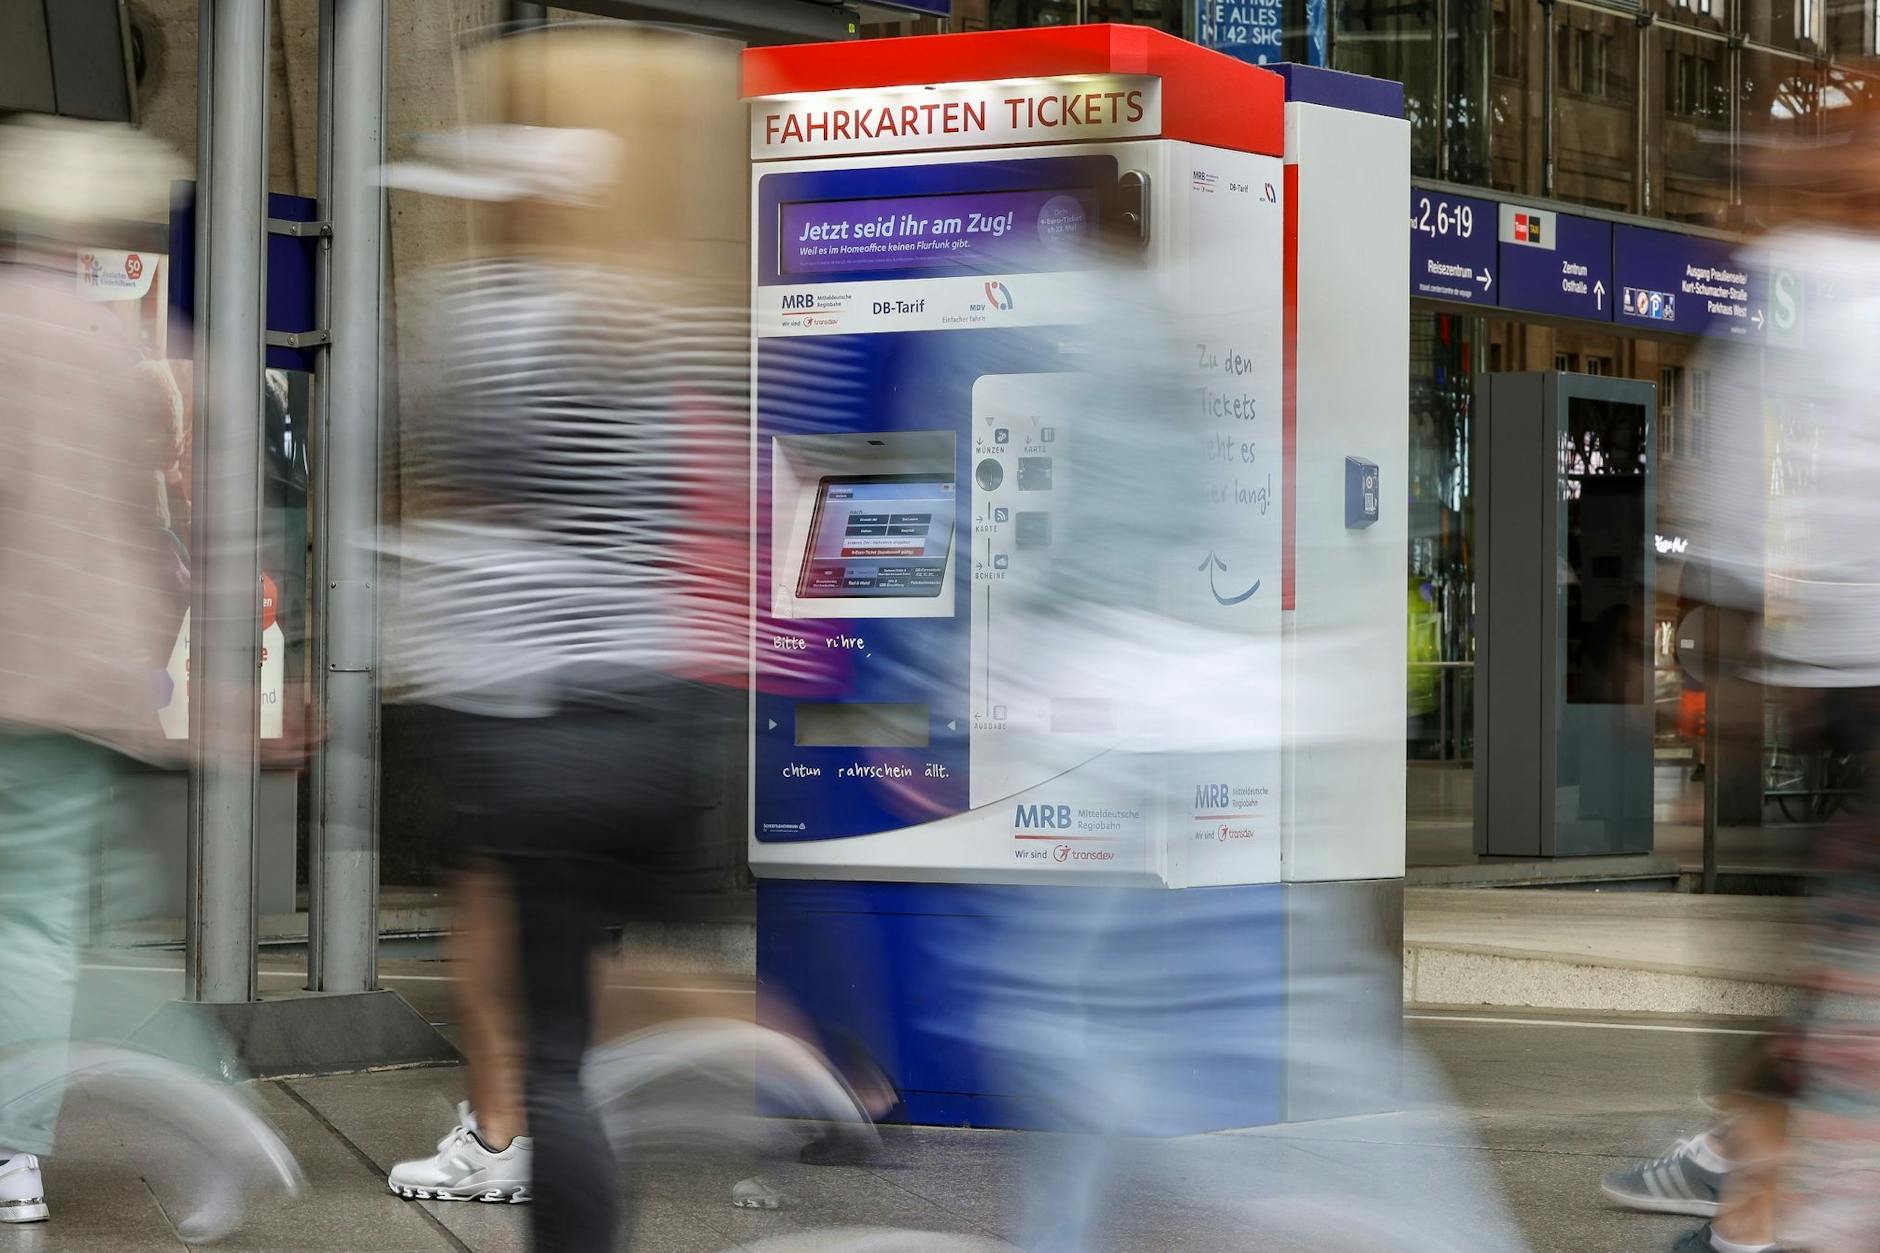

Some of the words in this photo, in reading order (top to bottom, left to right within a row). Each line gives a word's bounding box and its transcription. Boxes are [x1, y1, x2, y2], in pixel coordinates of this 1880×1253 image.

[1230, 7, 1278, 26] ALLES
[765, 101, 986, 144] FAHRKARTEN
[1004, 91, 1144, 130] TICKETS
[800, 221, 849, 242] Jetzt
[854, 215, 895, 239] seid
[899, 214, 928, 236] ihr
[932, 217, 961, 235] am
[967, 211, 1014, 237] Zug!
[800, 245, 818, 256] Weil
[818, 247, 828, 256] es
[829, 244, 839, 255] im
[840, 241, 887, 255] Homeoffice
[888, 240, 915, 252] keinen
[916, 239, 950, 251] Flurfunk
[952, 239, 971, 252] gibt.
[127, 260, 141, 274] 50
[1428, 259, 1473, 280] Reisezentrum
[1562, 260, 1588, 277] Zentrum
[1686, 264, 1710, 282] Ausgang
[1562, 278, 1588, 295] Osthalle
[781, 293, 814, 309] MRB
[817, 294, 852, 302] Mitteldeutsche
[1774, 270, 1797, 330] S
[872, 299, 925, 315] DB-Tarif
[1707, 300, 1733, 316] Parkhaus
[1732, 304, 1748, 318] West
[1196, 343, 1219, 369] Zu
[1224, 348, 1252, 376] den
[1197, 387, 1256, 420] Tickets
[1203, 431, 1235, 462] eht
[1240, 441, 1256, 464] es
[1234, 472, 1272, 516] lang!
[975, 572, 1006, 580] SCHEINE
[773, 636, 807, 650] Bitte
[1195, 783, 1230, 809] MRB
[1232, 786, 1269, 796] Mitteldeutsche
[1015, 804, 1072, 829] MRB
[1078, 808, 1141, 819] Mitteldeutsche
[1078, 820, 1121, 832] Regiobahn
[1015, 849, 1029, 859] Wir
[1030, 849, 1048, 859] sind
[1071, 849, 1115, 861] transdev
